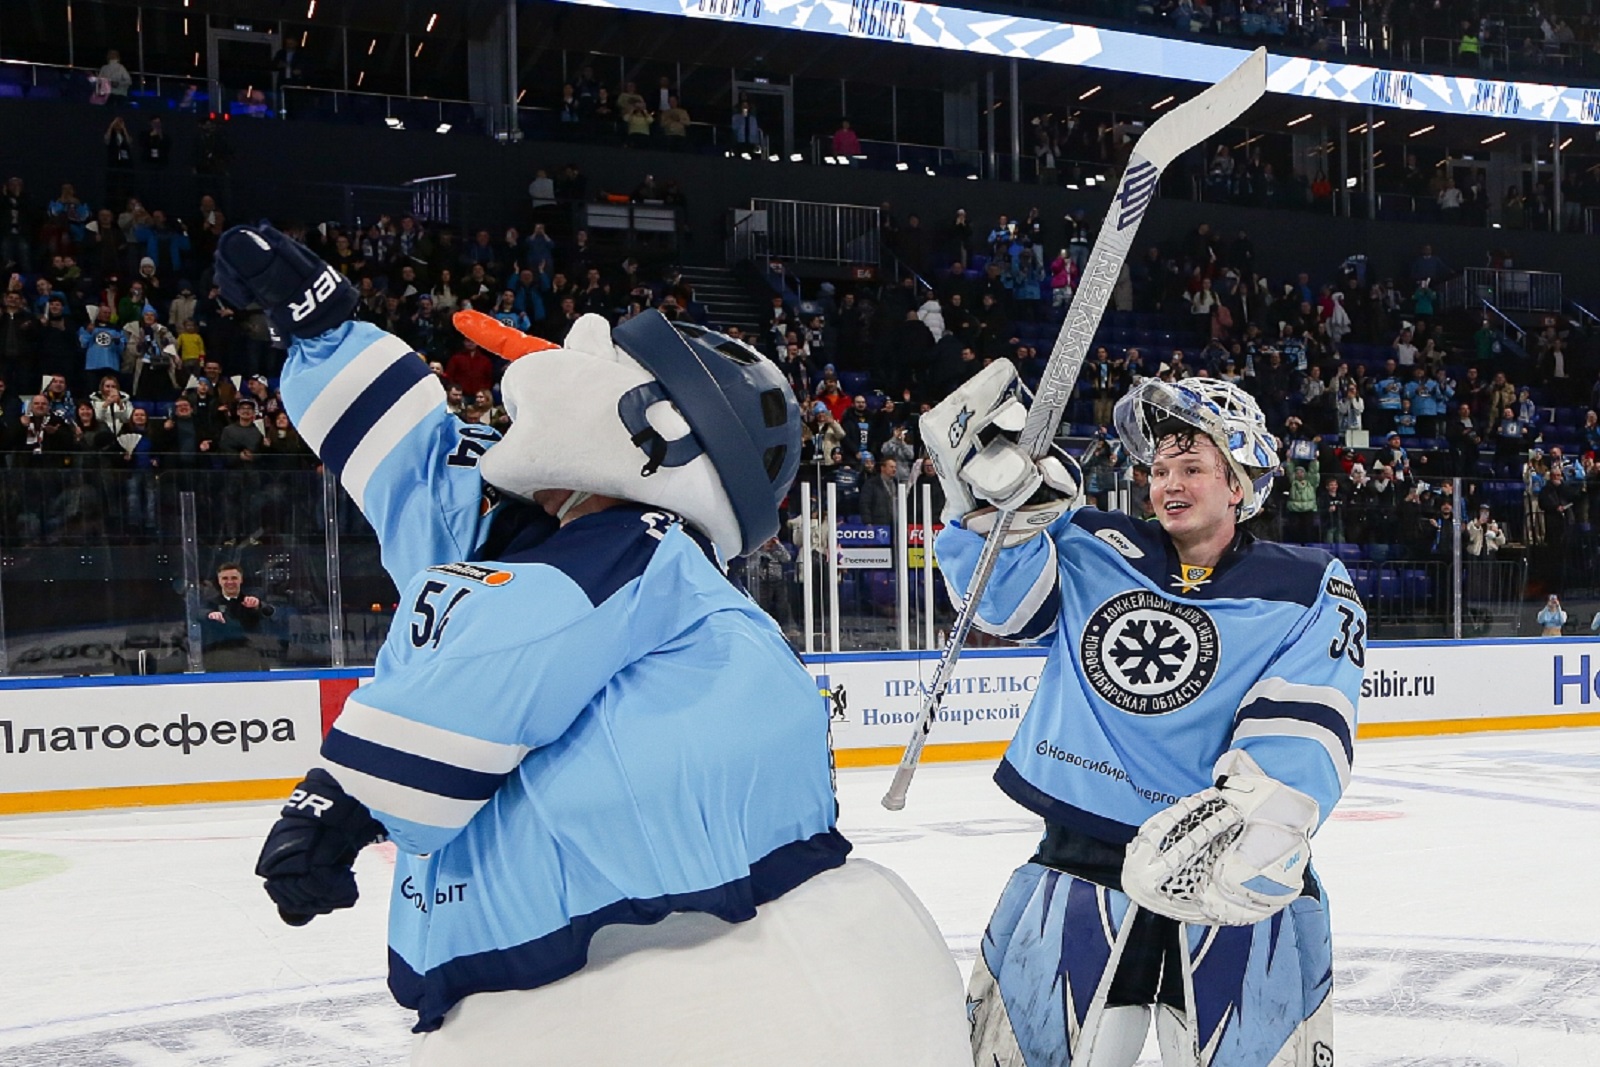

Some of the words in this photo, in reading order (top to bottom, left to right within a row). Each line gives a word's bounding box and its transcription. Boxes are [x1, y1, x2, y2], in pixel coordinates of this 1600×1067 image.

[848, 0, 906, 39] СИБИРЬ
[1371, 71, 1413, 104] СИБИРЬ
[1475, 82, 1520, 115] СИБИРЬ
[1041, 250, 1125, 409] REKKER
[1100, 592, 1173, 623] ХОККЕЙНЫЙ
[1196, 620, 1214, 663] СИБИРЬ
[1328, 603, 1366, 669] 33
[884, 675, 1041, 698] ПРАИТЕЛЬС
[1085, 634, 1148, 712] НОВОСИБИРСКАЯ
[1152, 679, 1203, 711] ОБЛАСТЬ
[862, 703, 1021, 726] Новобирской
